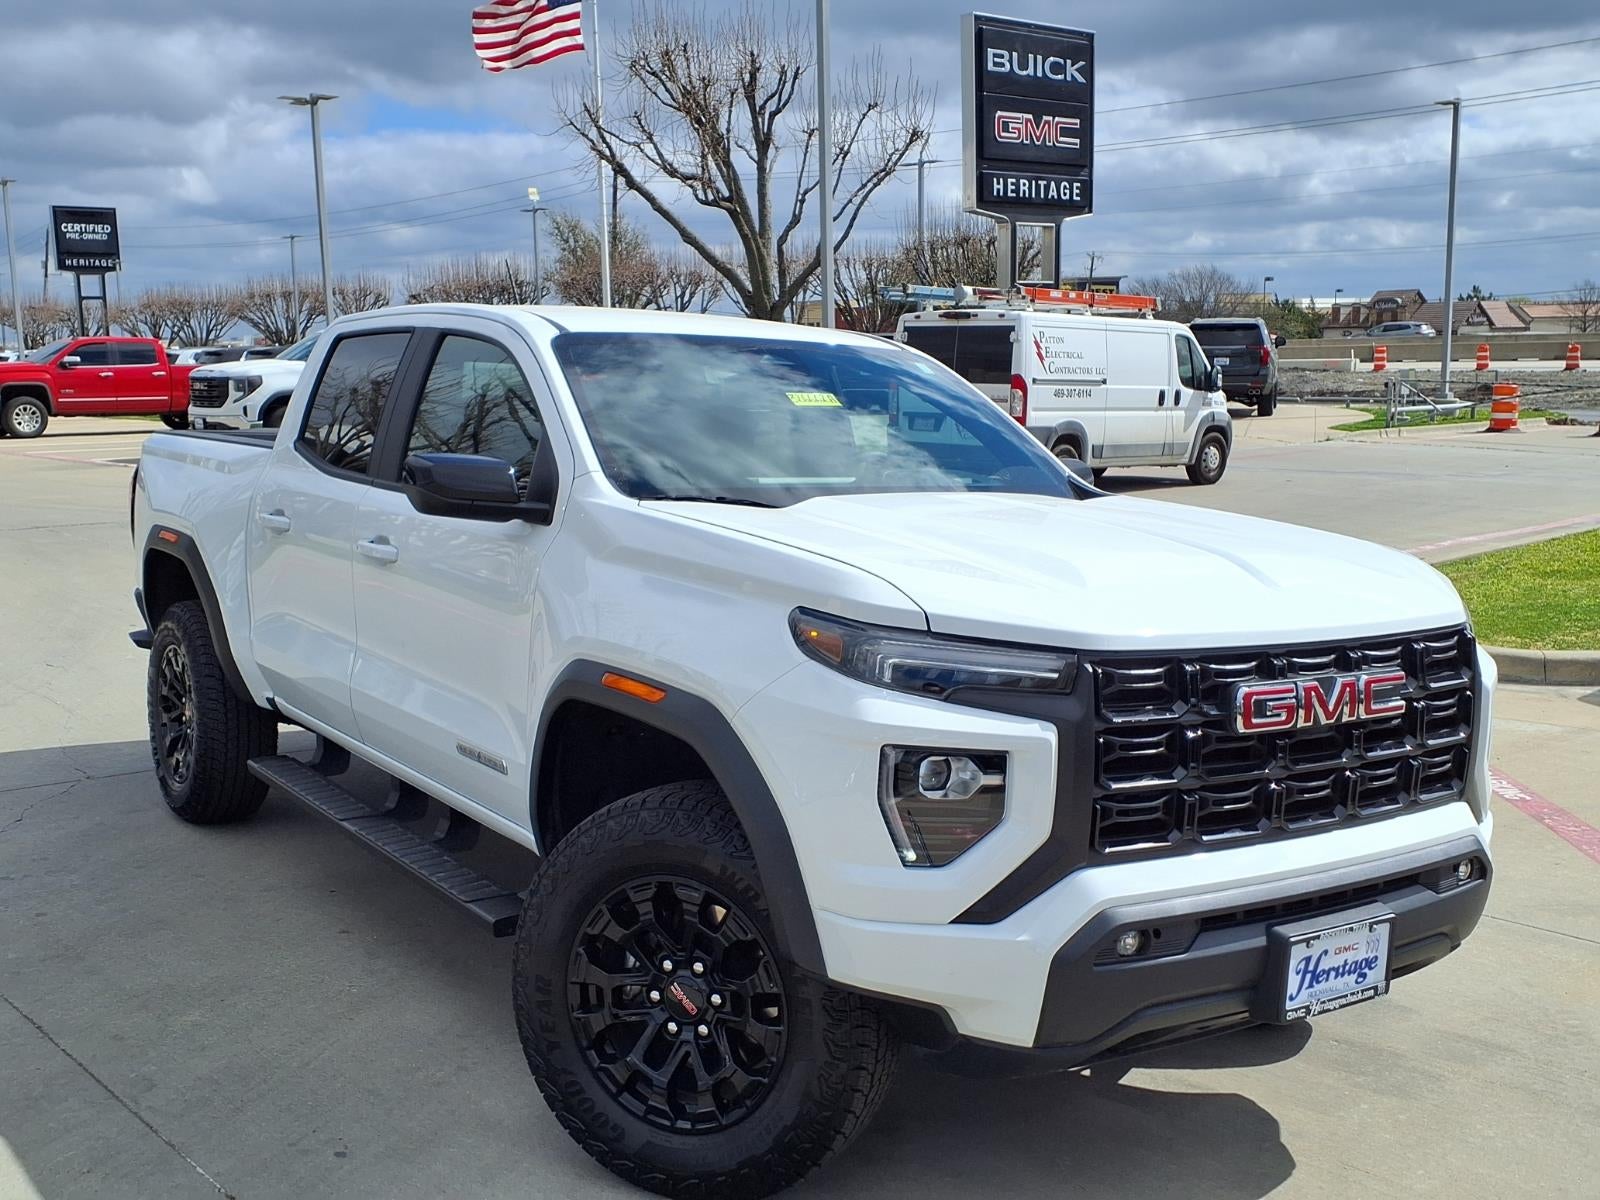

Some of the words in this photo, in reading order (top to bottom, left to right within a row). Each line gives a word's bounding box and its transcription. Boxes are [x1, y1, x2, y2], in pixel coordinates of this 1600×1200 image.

[987, 47, 1087, 84] BUICK
[995, 110, 1081, 149] GMC
[993, 177, 1081, 201] HERITAGE
[61, 223, 111, 233] CERTIFIED
[66, 232, 108, 240] PRE-OWNED
[65, 258, 114, 267] HERITAGE
[1095, 367, 1106, 375] LLC
[1053, 388, 1092, 399] 469-307-6114
[1236, 671, 1407, 733] GMC
[1334, 942, 1360, 956] GMC
[1287, 949, 1379, 1002] Heritage
[670, 982, 698, 1016] GMC
[1286, 1009, 1307, 1021] GMC
